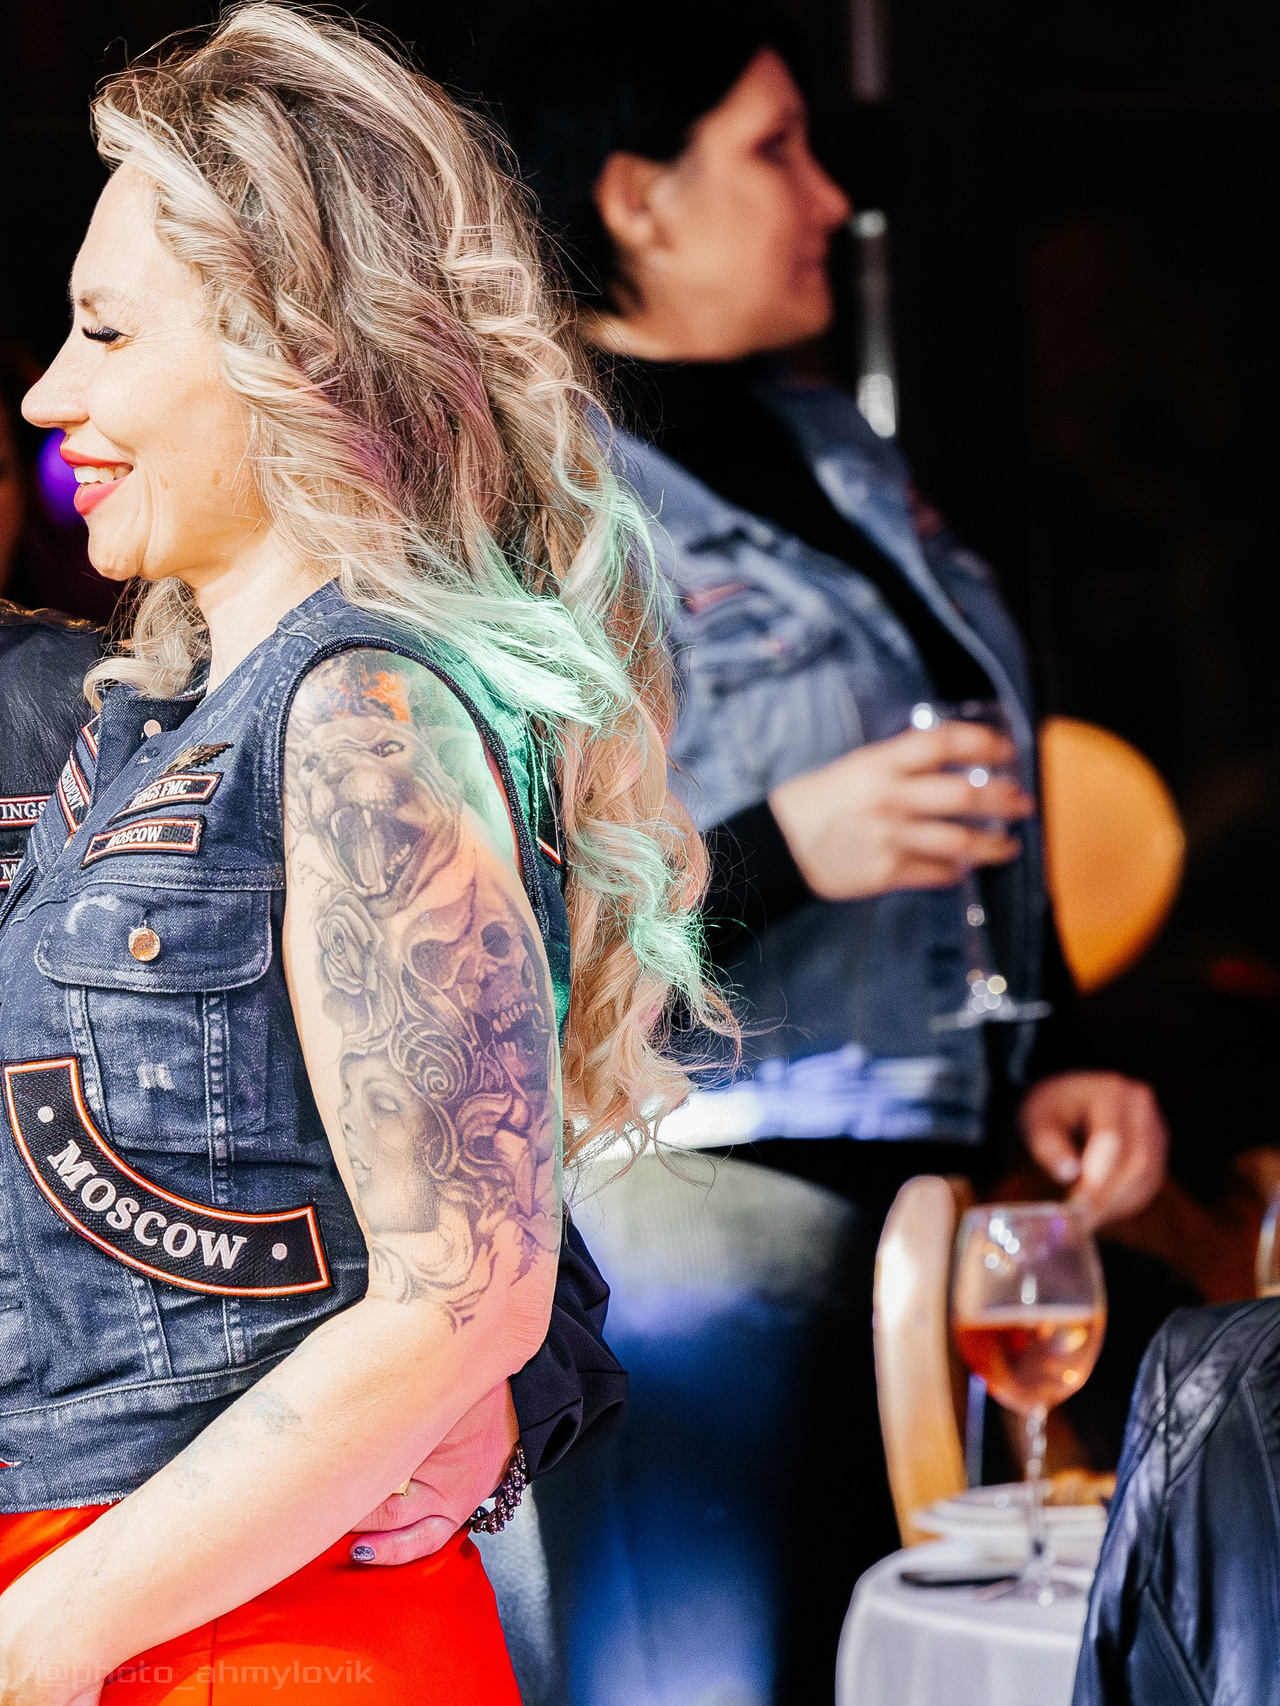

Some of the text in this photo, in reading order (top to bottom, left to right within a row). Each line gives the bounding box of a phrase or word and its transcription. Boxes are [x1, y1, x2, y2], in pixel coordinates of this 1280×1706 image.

[160, 780, 192, 798] FMC
[105, 825, 163, 849] MOSCOW
[47, 1139, 248, 1270] MOSCOW
